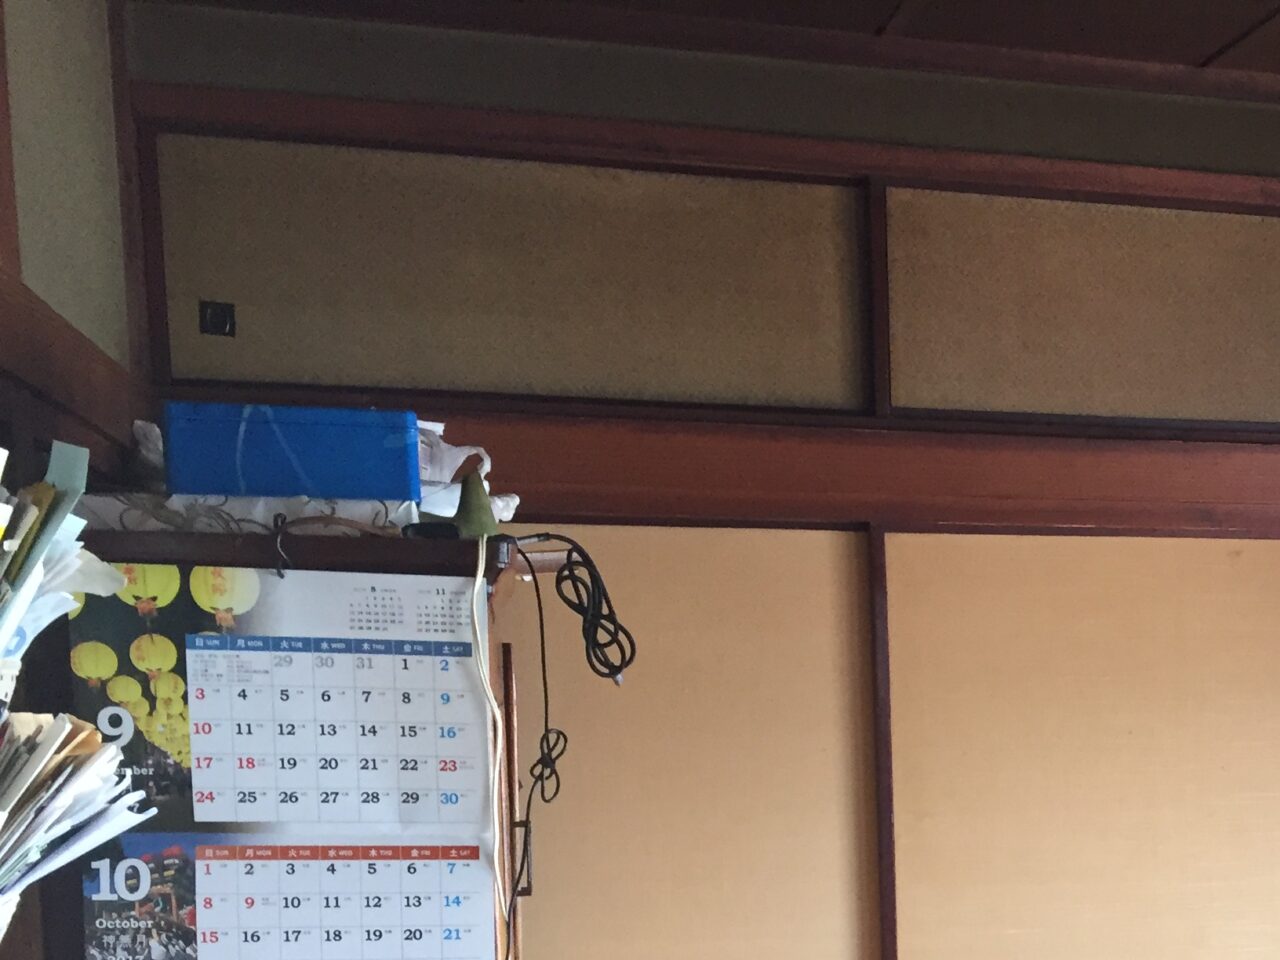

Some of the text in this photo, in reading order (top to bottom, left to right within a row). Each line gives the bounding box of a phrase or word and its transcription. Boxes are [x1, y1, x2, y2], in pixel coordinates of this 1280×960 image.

[435, 587, 446, 596] 11
[273, 655, 448, 671] 29 30 31 1 2
[196, 688, 450, 704] 3 4 5 6 7 8 9
[96, 705, 135, 752] 9
[194, 723, 456, 738] 10 11 12 13 14 15 16
[196, 757, 457, 771] 17 18 19 20 21 22 23
[195, 791, 458, 804] 24 25 26 27 28 29 30
[204, 863, 456, 876] 1 2 3 4 5 6 7
[90, 857, 151, 901] 10
[204, 896, 461, 909] 8 9 10 11 12 13 14
[95, 918, 154, 929] October
[202, 928, 461, 943] 15 16 17 18 19 20 21
